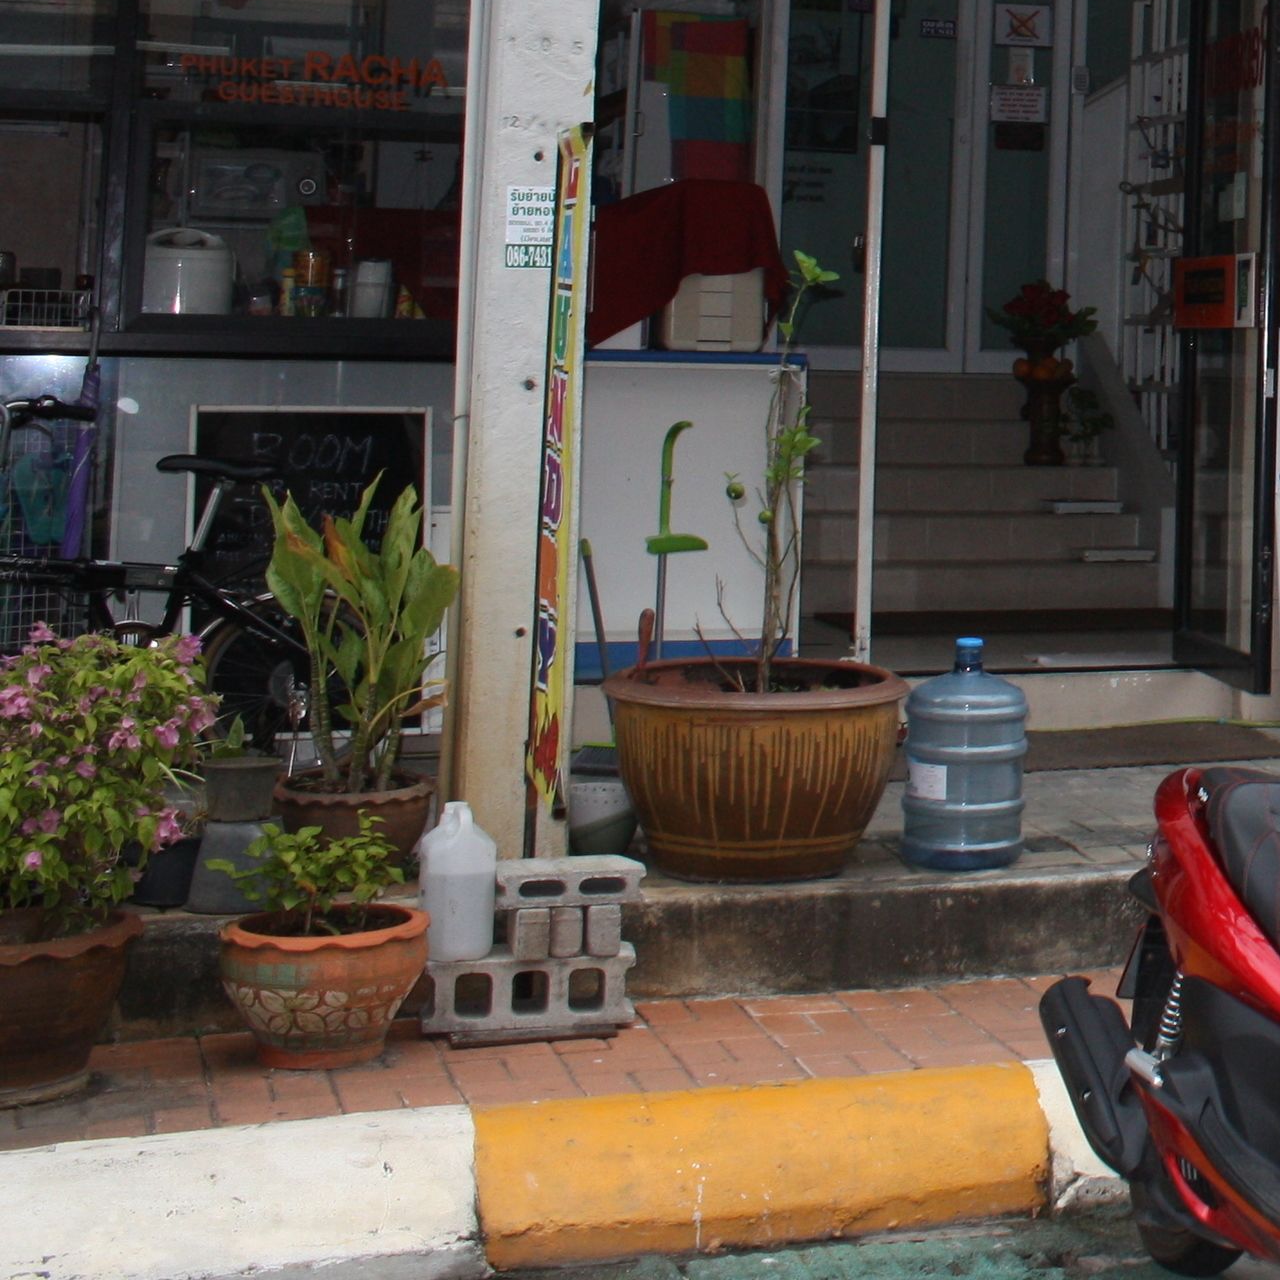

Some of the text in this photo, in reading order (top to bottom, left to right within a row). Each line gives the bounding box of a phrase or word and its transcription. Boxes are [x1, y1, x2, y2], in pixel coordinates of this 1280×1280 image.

[181, 51, 449, 89] PHUKET RACHA
[217, 80, 409, 111] GUESTHOUSE
